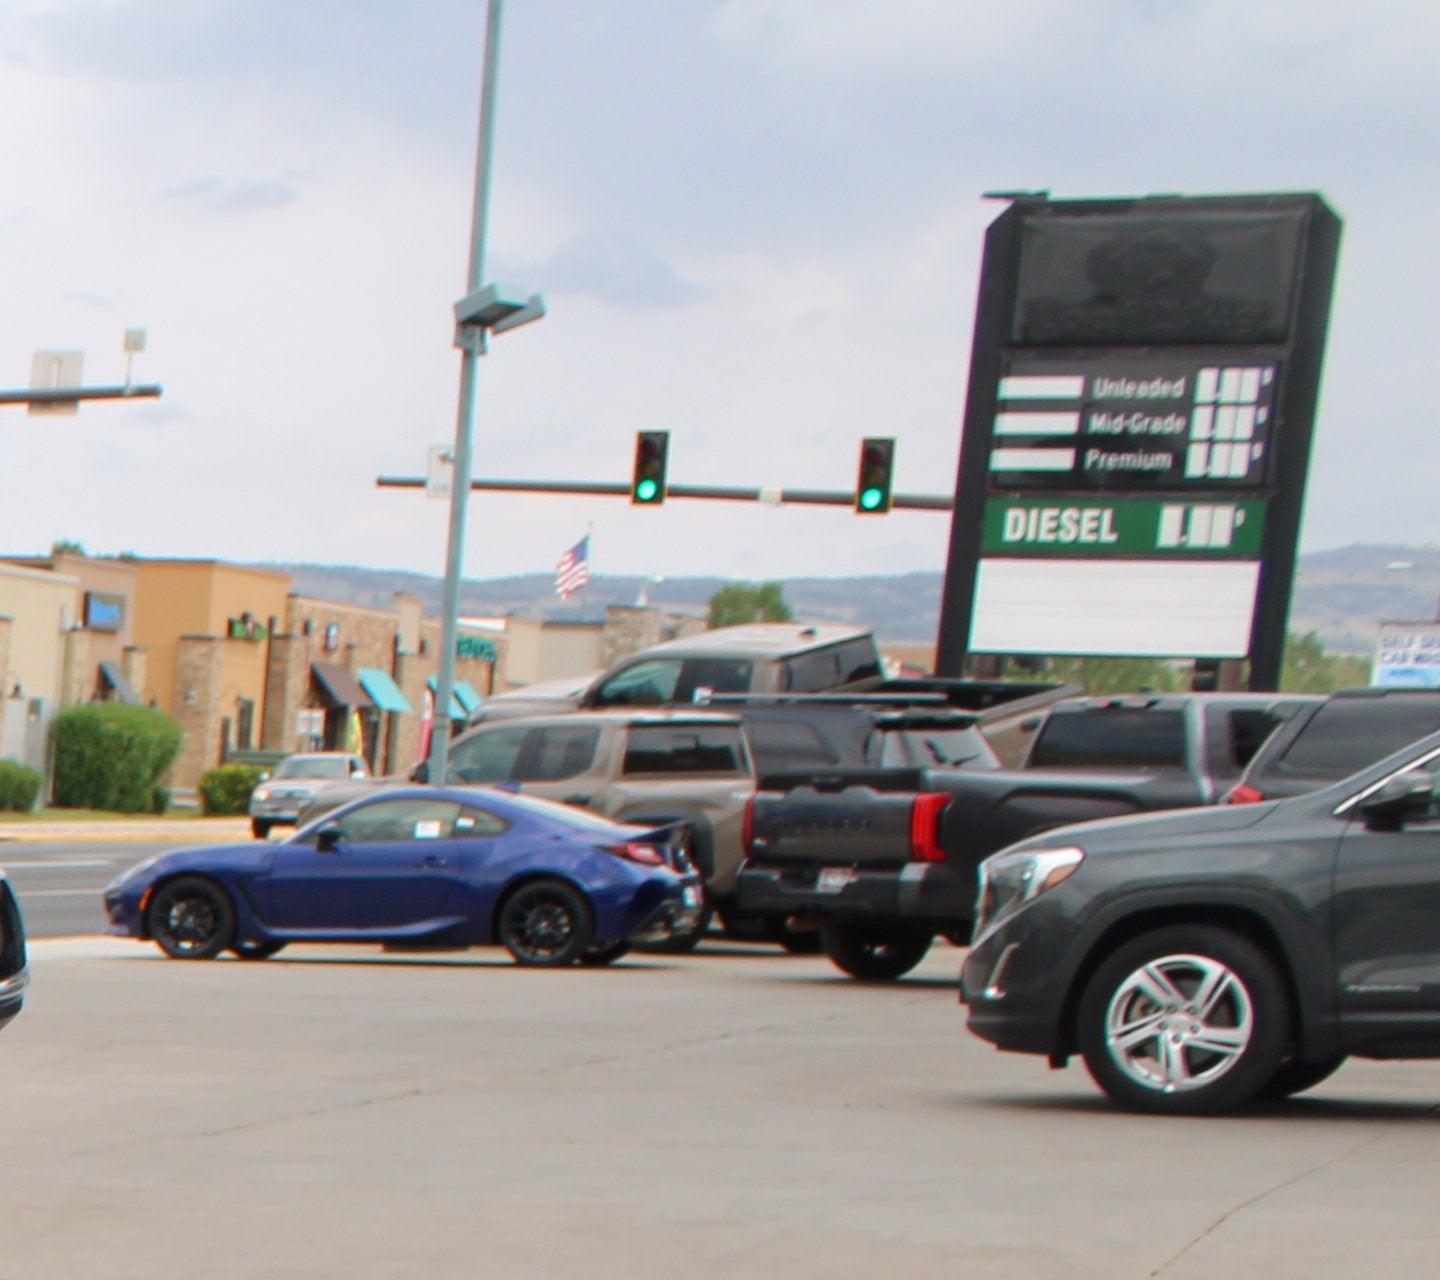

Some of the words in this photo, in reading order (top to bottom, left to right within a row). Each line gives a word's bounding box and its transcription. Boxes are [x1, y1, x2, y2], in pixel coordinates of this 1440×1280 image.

[1091, 376, 1187, 399] Unleaded
[1088, 412, 1187, 435] Mid-Grade
[1083, 449, 1174, 471] Premium
[1002, 507, 1119, 543] DIESEL
